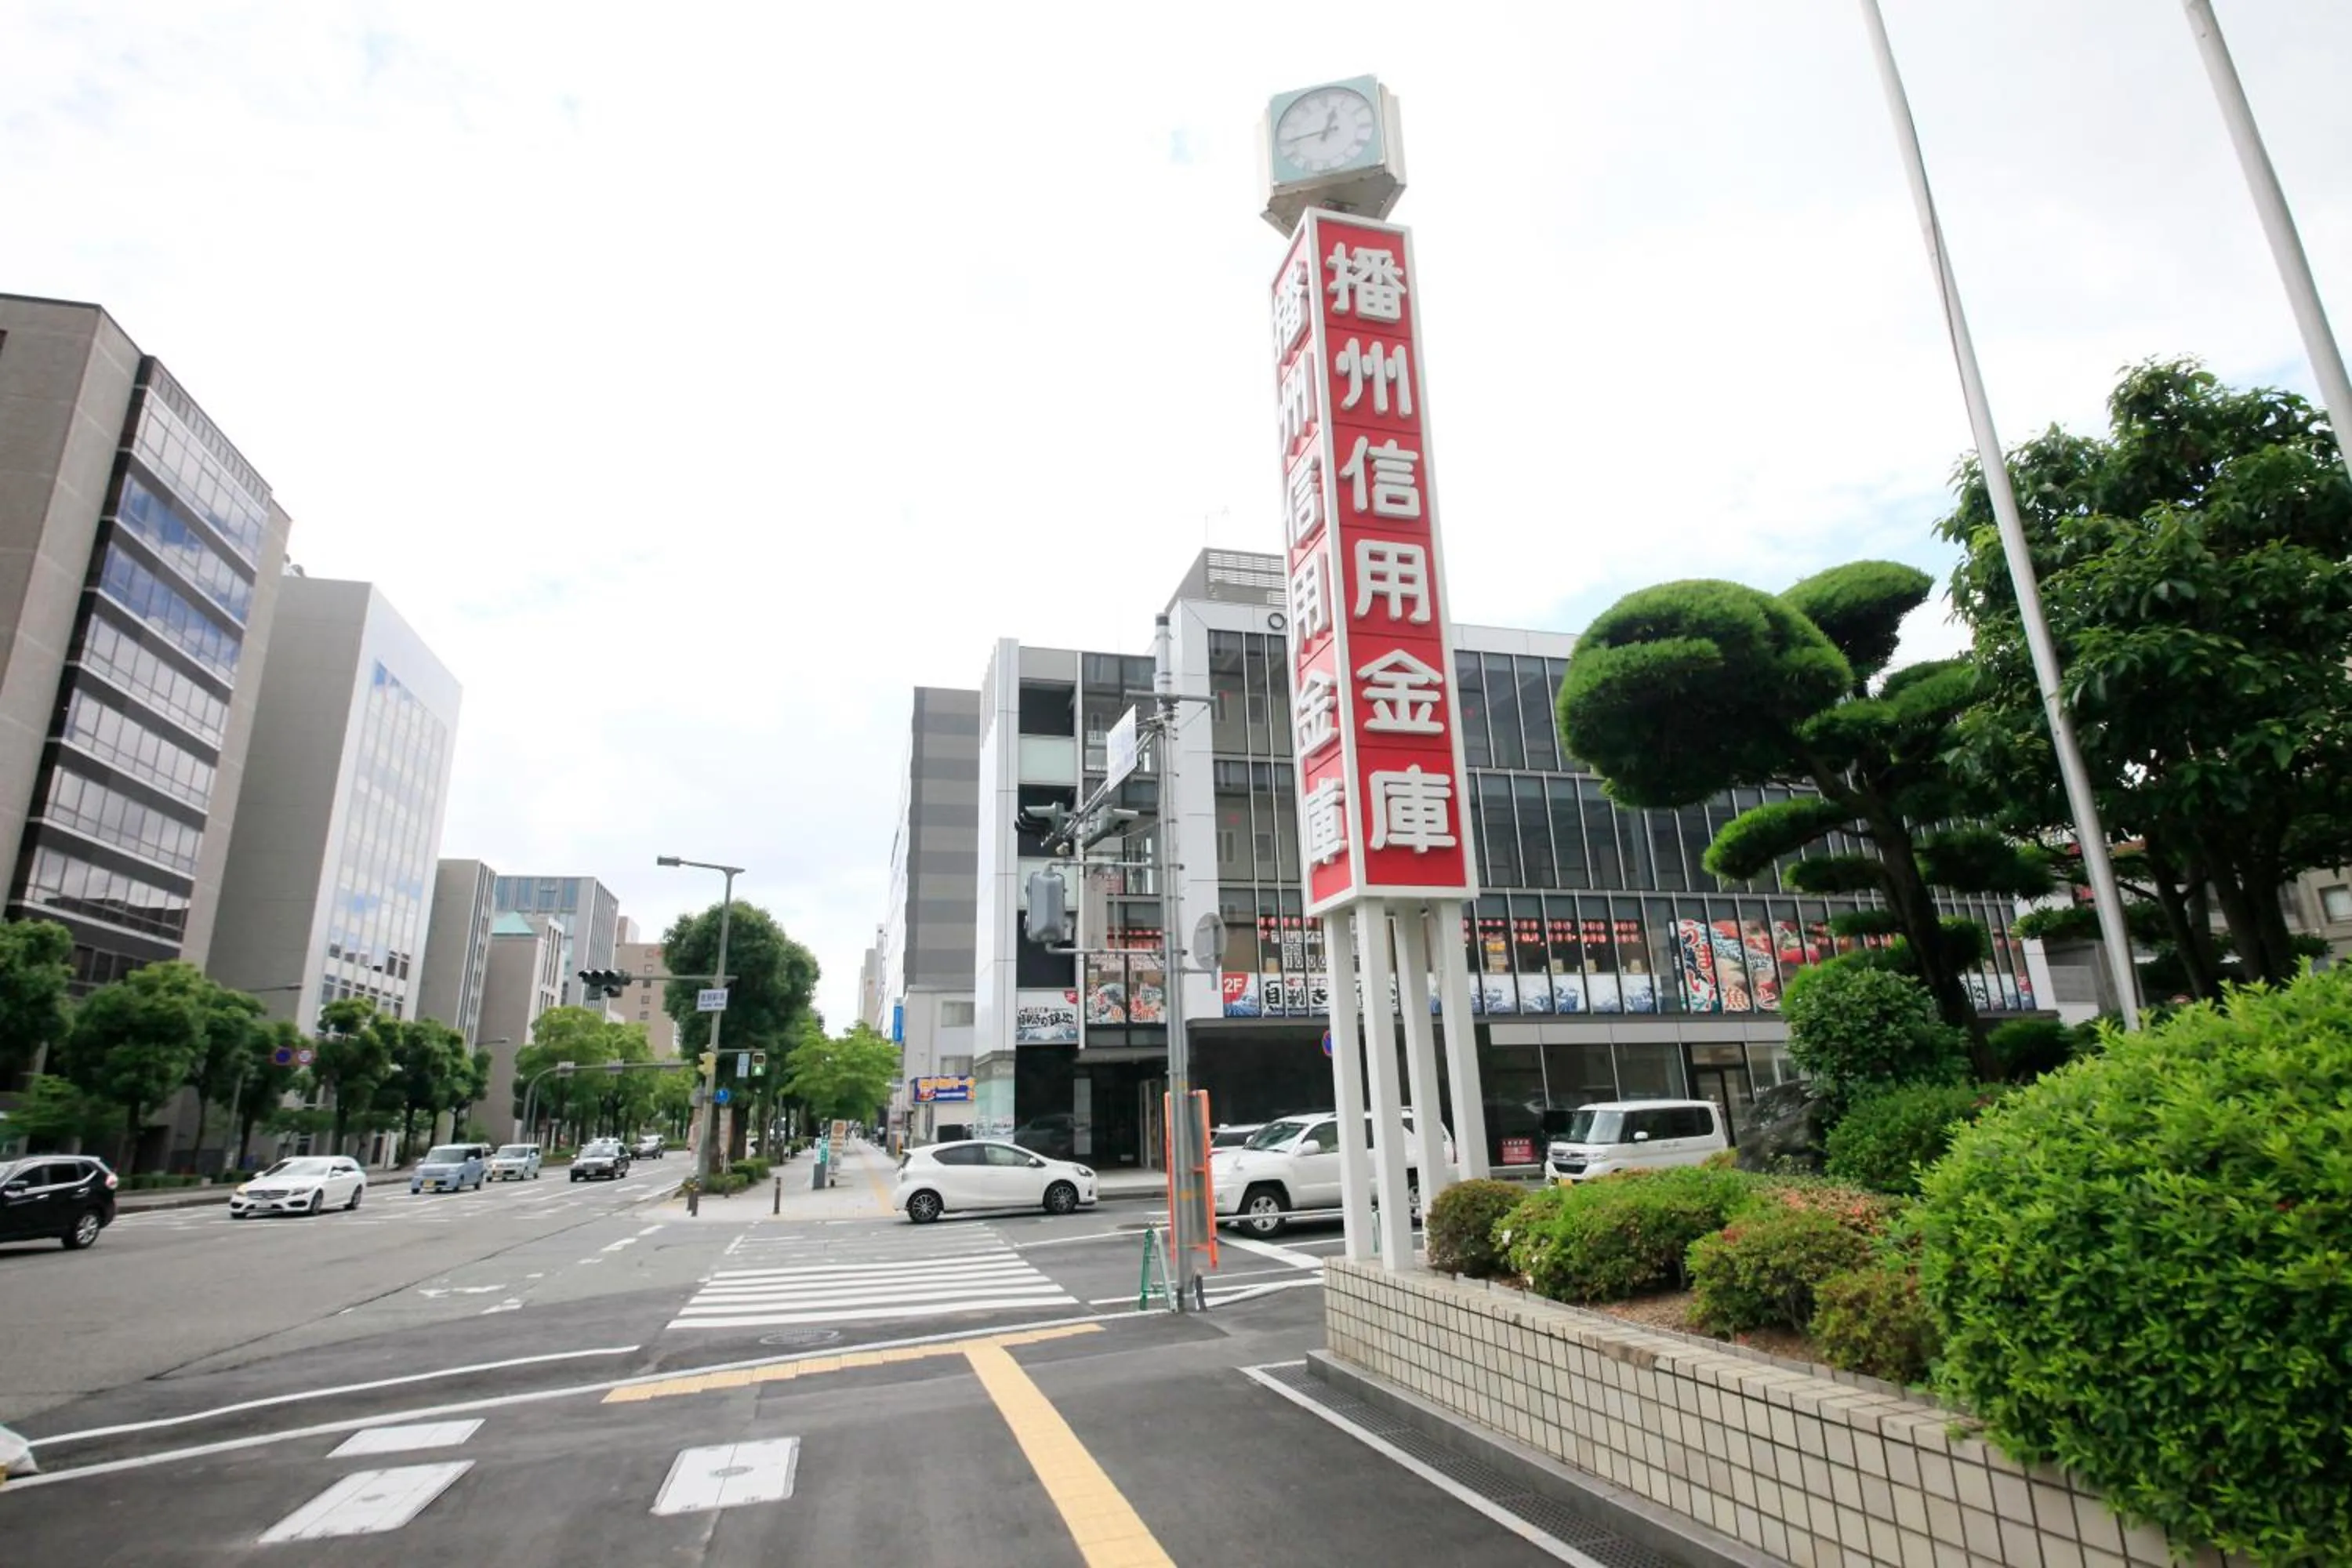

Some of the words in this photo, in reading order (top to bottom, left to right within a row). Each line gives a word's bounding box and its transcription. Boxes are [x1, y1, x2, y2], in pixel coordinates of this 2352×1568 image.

[1272, 260, 1348, 864] 播州信用金庫
[1326, 241, 1457, 853] 播州信用金庫
[1224, 978, 1243, 994] 2F
